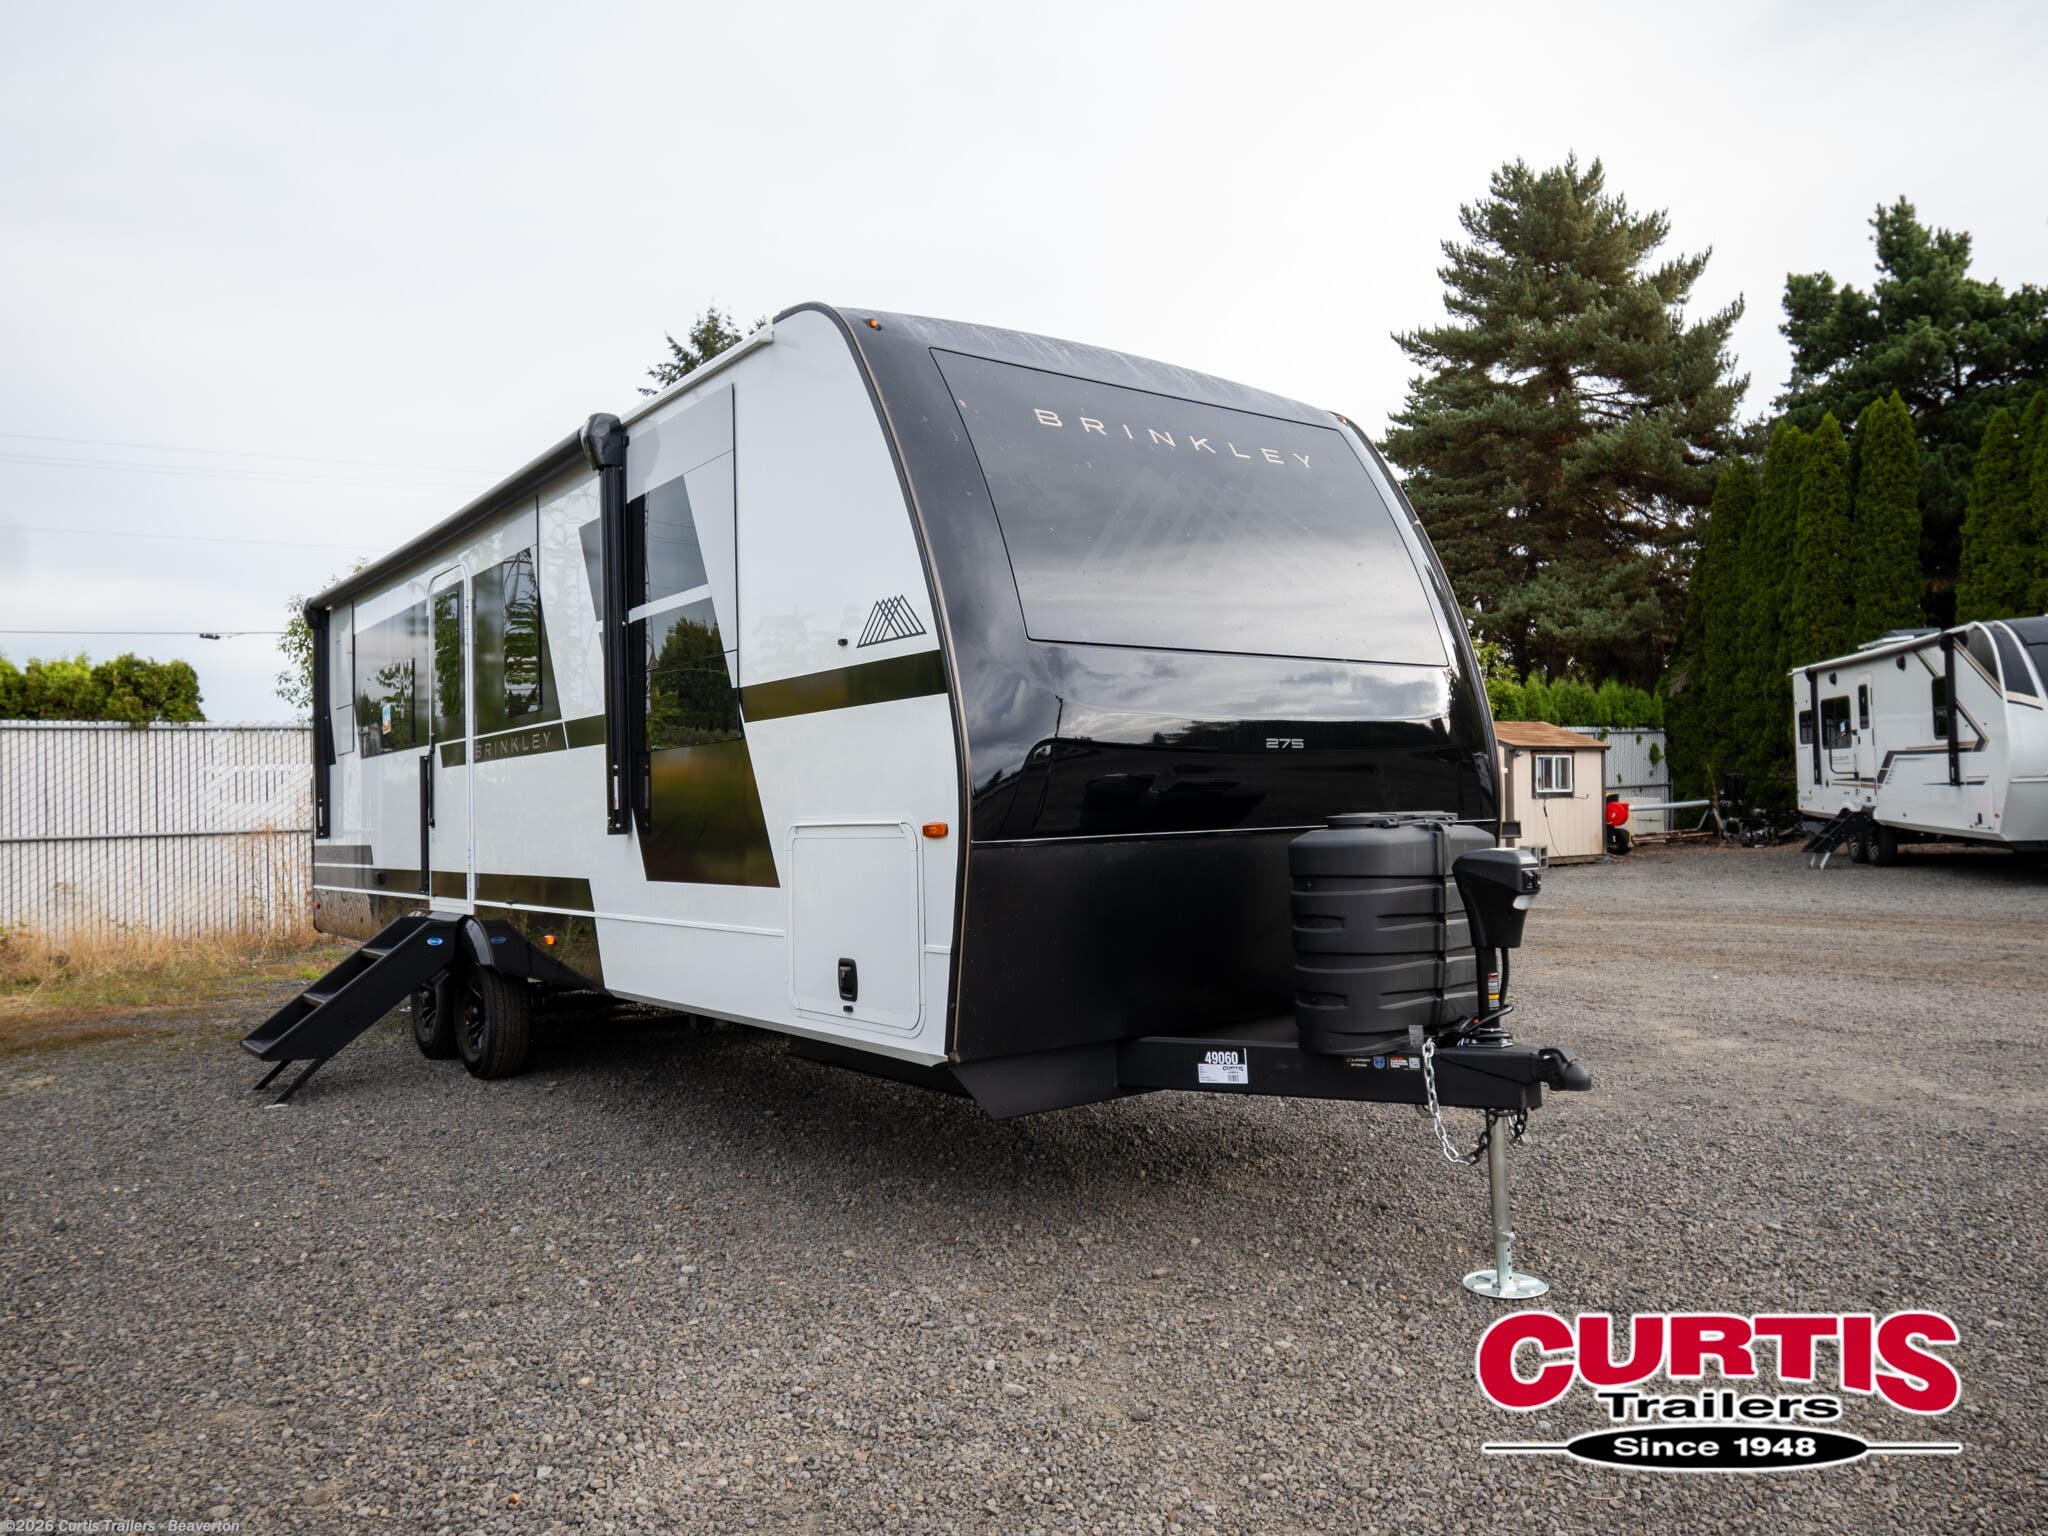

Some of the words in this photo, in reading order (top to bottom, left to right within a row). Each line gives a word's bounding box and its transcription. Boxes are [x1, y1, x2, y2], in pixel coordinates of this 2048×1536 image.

[1032, 407, 1311, 469] BRINKLEY
[474, 731, 553, 760] BRINKLEY
[1265, 737, 1305, 749] 275
[1204, 1051, 1239, 1065] 49060
